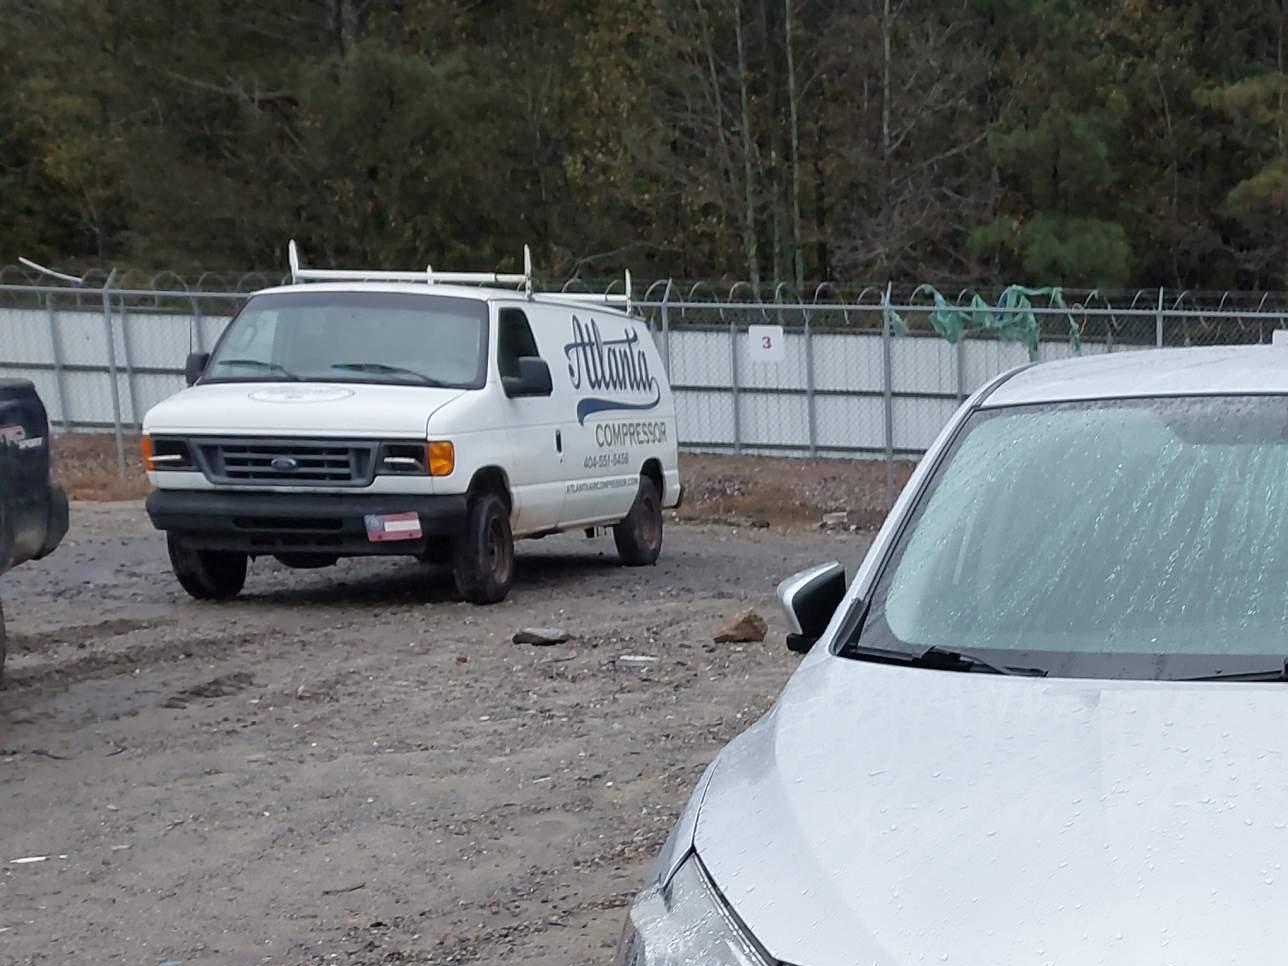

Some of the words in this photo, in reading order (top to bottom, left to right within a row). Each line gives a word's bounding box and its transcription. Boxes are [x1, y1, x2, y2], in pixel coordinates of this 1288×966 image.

[564, 314, 660, 395] Atlanta
[762, 336, 772, 349] 3
[596, 423, 667, 447] COMPRESSOR
